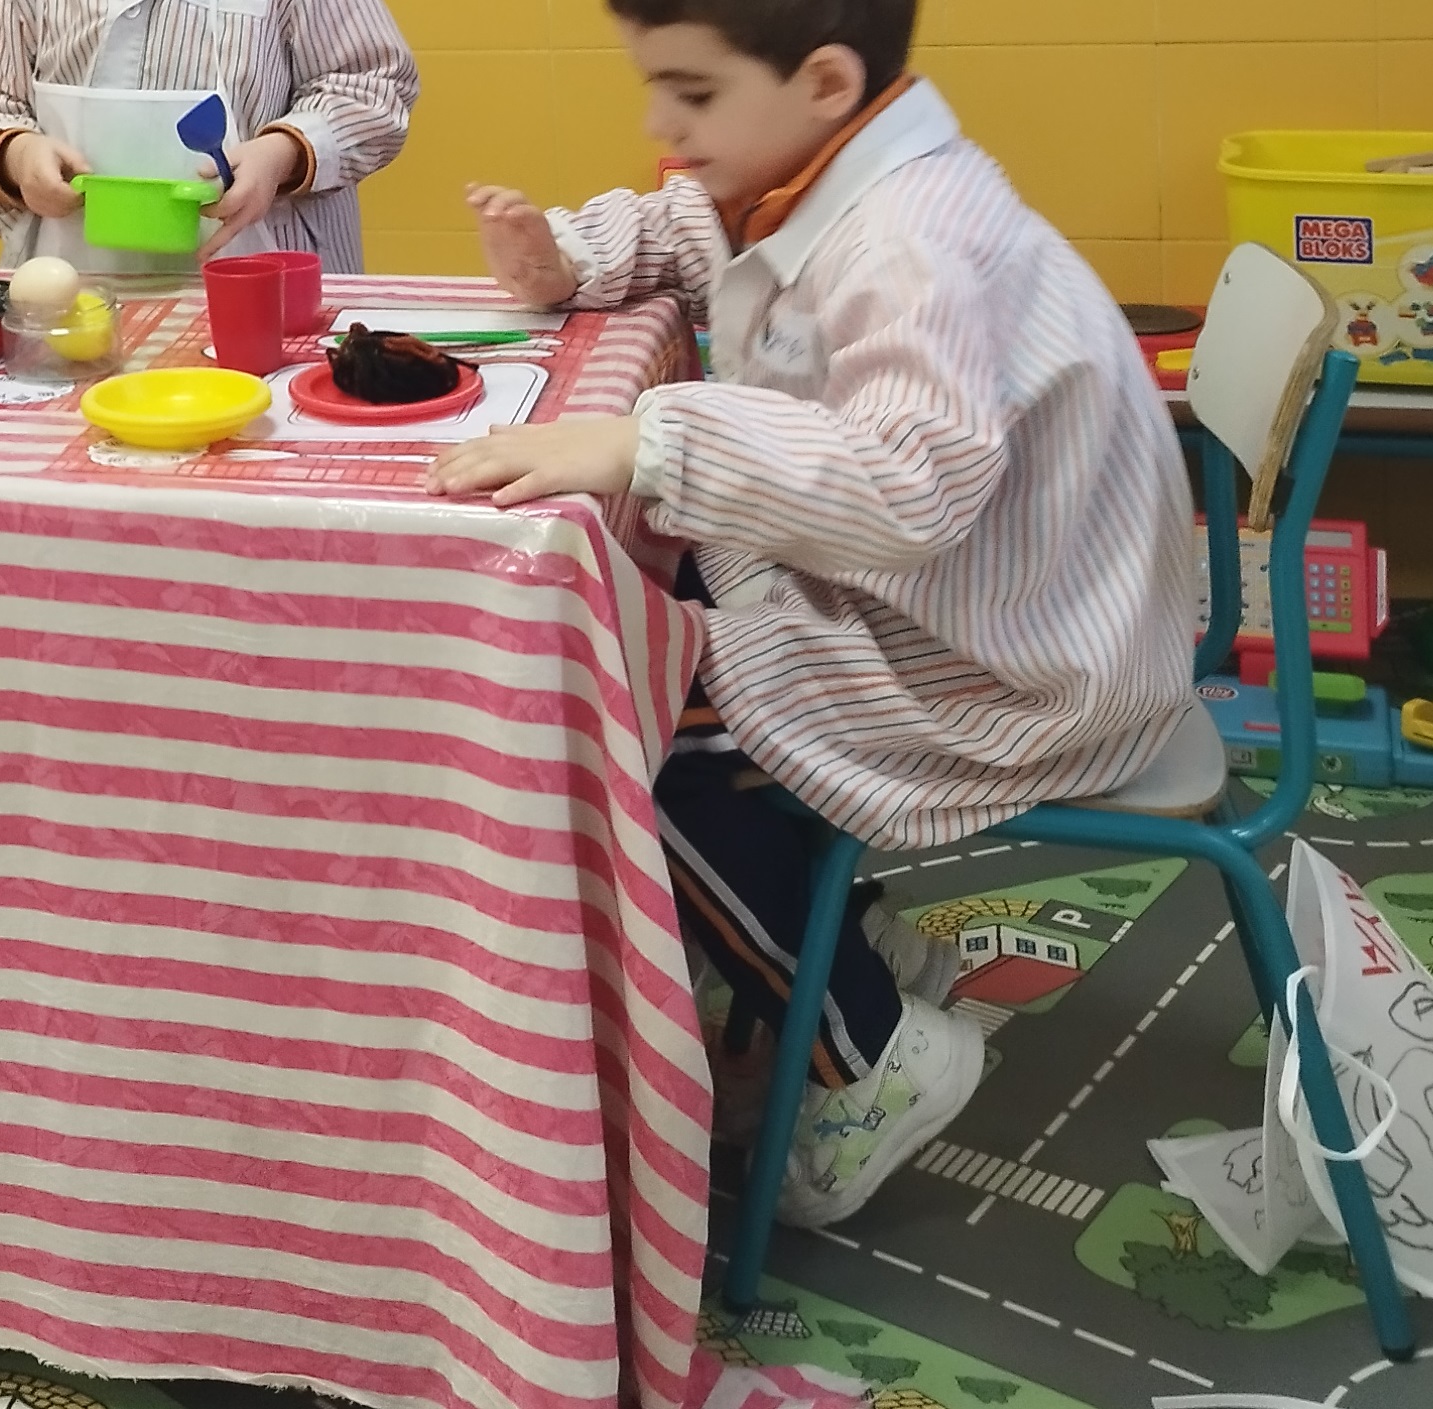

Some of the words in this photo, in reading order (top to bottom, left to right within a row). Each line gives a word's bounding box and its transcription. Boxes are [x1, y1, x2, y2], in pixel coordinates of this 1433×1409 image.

[1300, 220, 1367, 239] MEGA
[1301, 240, 1369, 259] BLOKS
[1050, 908, 1093, 930] P
